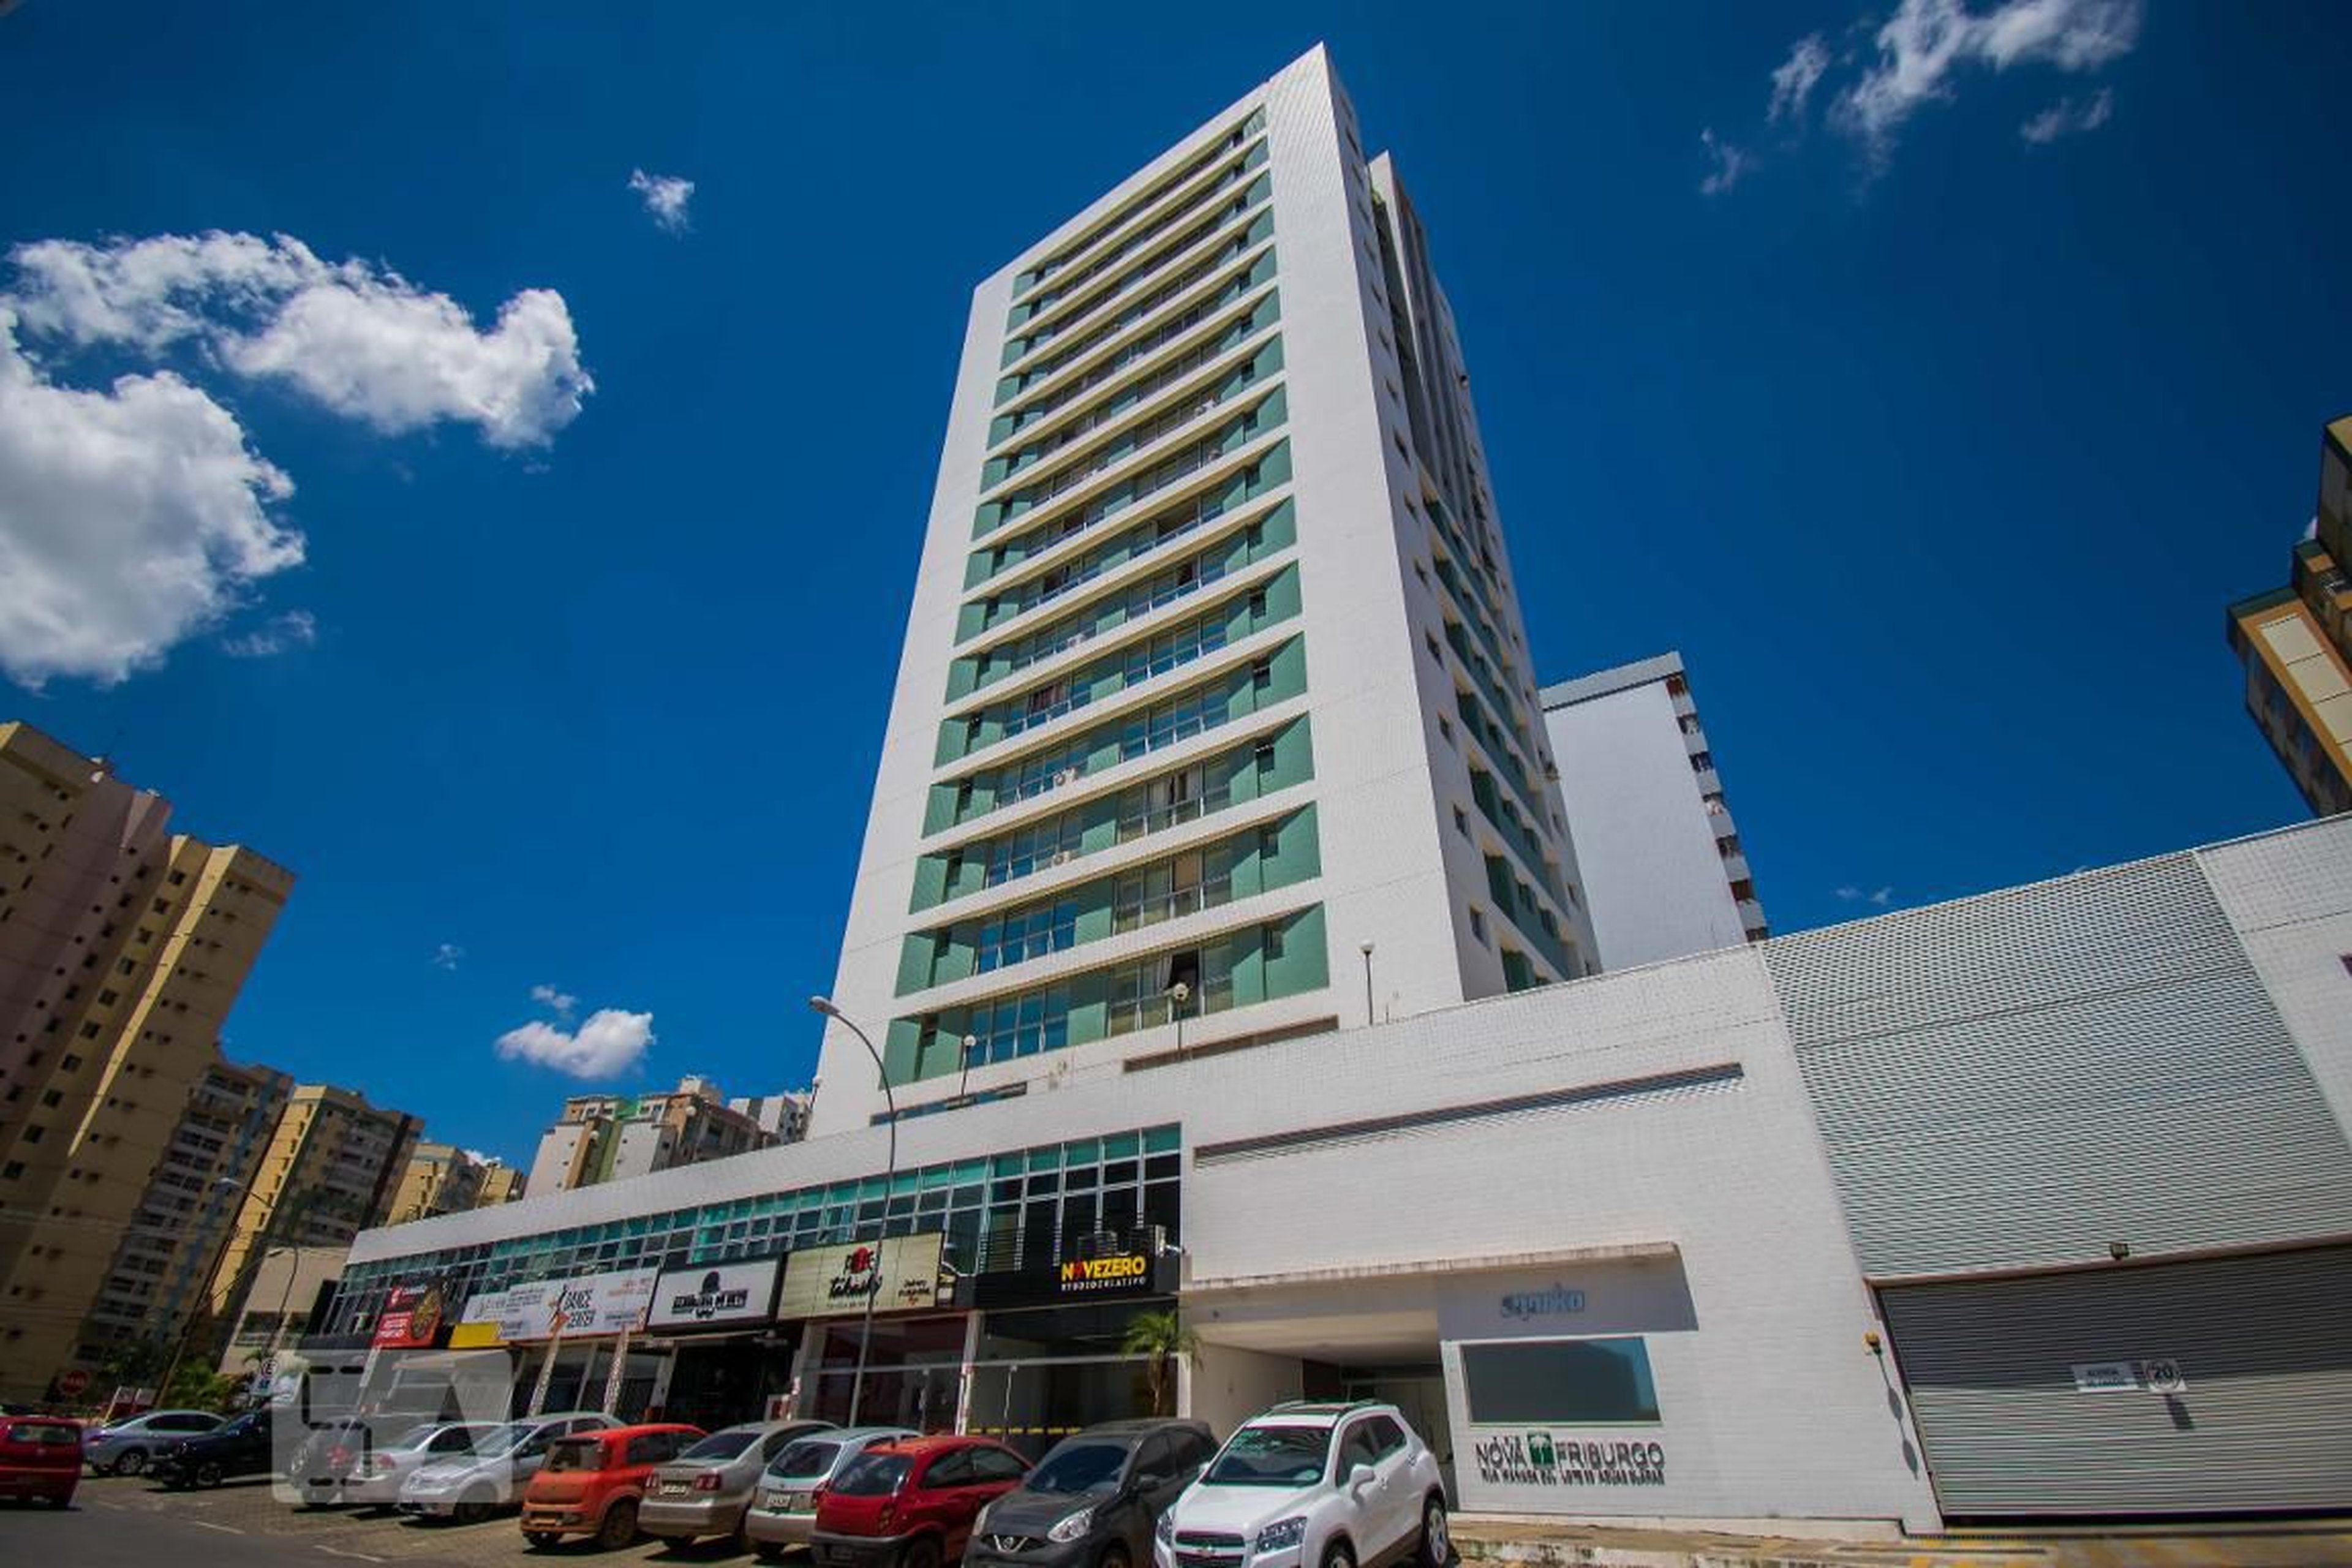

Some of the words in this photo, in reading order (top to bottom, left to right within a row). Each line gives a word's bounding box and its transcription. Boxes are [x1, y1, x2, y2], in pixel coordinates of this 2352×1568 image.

[1061, 1256, 1145, 1282] NOVEZERO
[1476, 1439, 1528, 1470] NOVA
[1555, 1441, 1665, 1470] FRIBURGO
